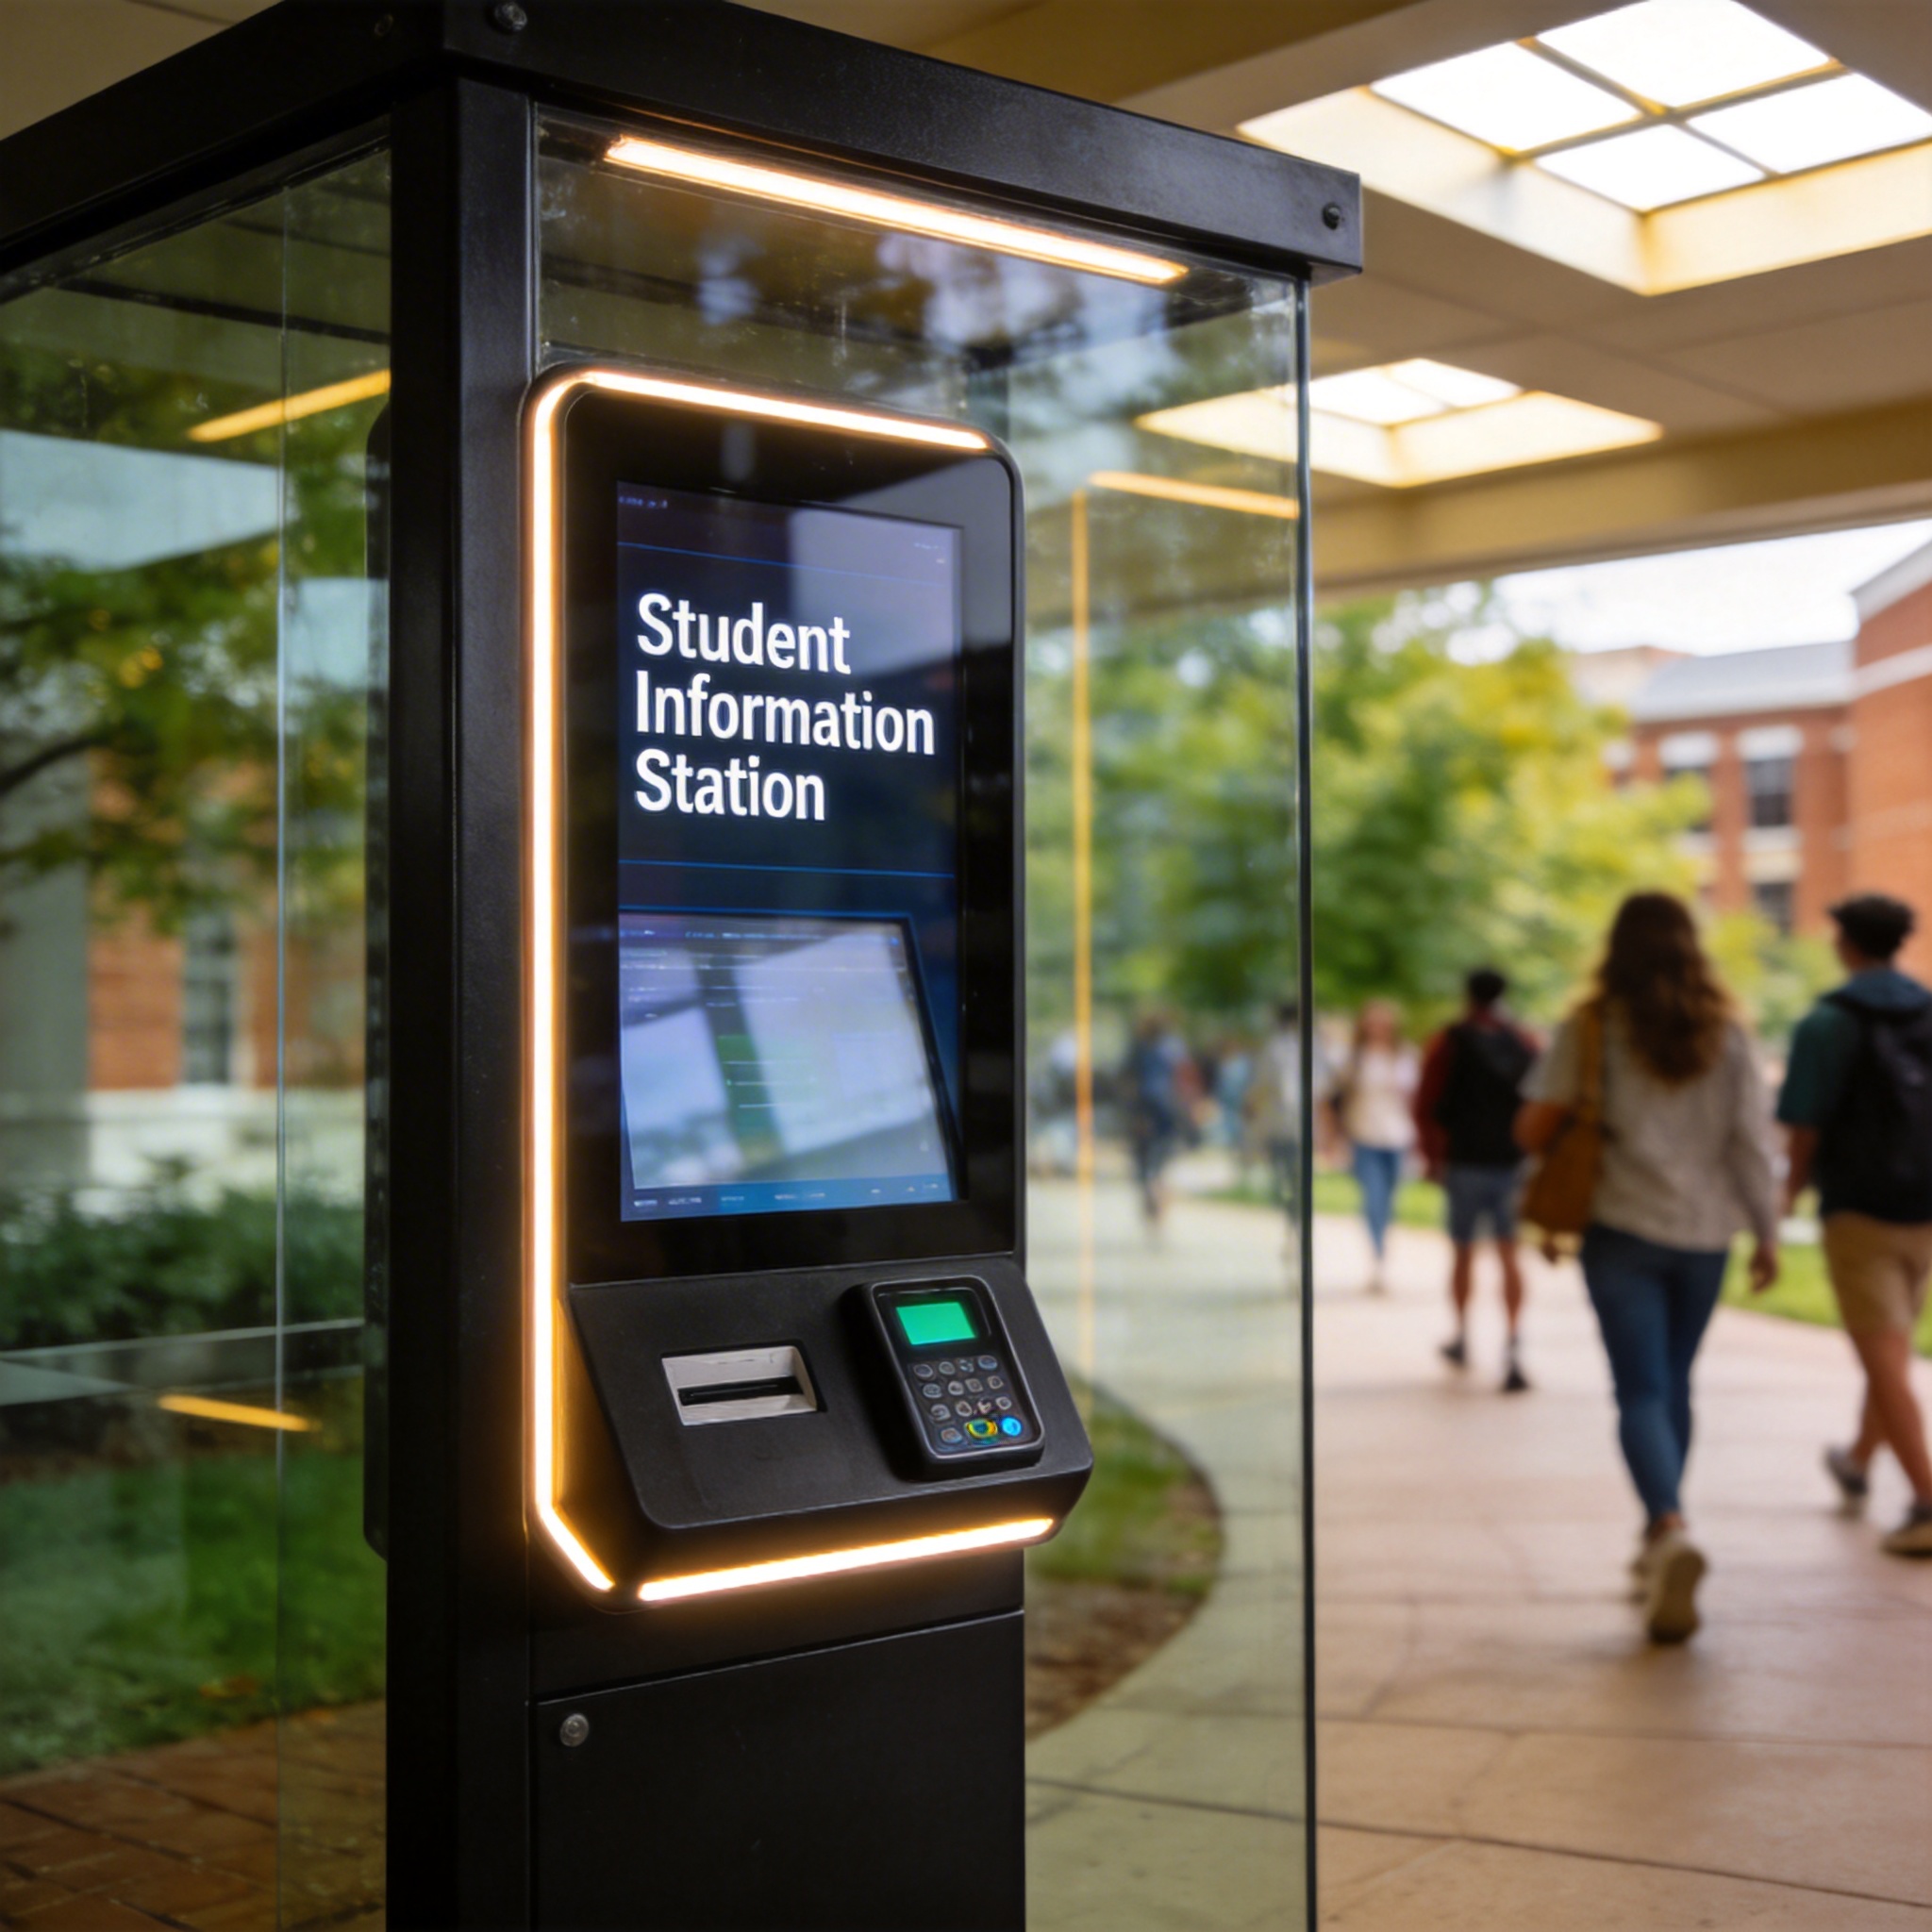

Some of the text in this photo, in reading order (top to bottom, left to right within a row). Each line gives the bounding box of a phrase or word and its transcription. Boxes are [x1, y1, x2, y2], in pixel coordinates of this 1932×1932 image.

[637, 592, 851, 675] Student
[636, 670, 934, 755] Information
[635, 748, 825, 821] Station
